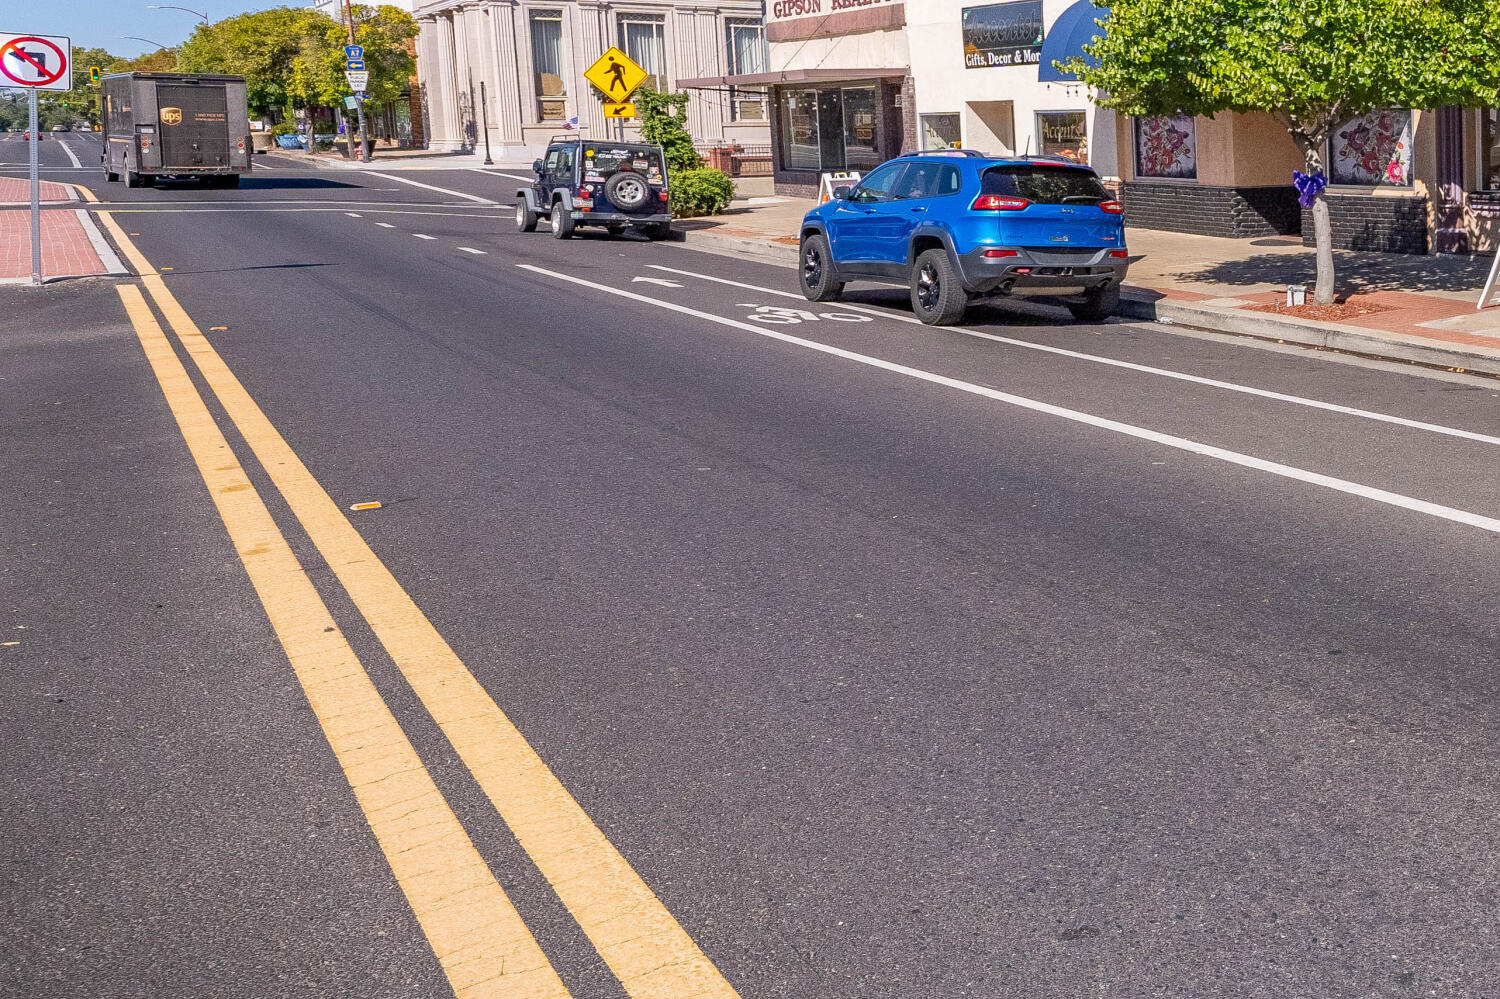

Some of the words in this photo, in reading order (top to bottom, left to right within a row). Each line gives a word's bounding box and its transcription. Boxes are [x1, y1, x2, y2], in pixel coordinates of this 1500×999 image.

[965, 53, 988, 67] Gifts,
[987, 52, 1012, 65] Decor
[1014, 50, 1022, 63] &
[1023, 48, 1041, 63] Mor
[162, 112, 181, 123] ups
